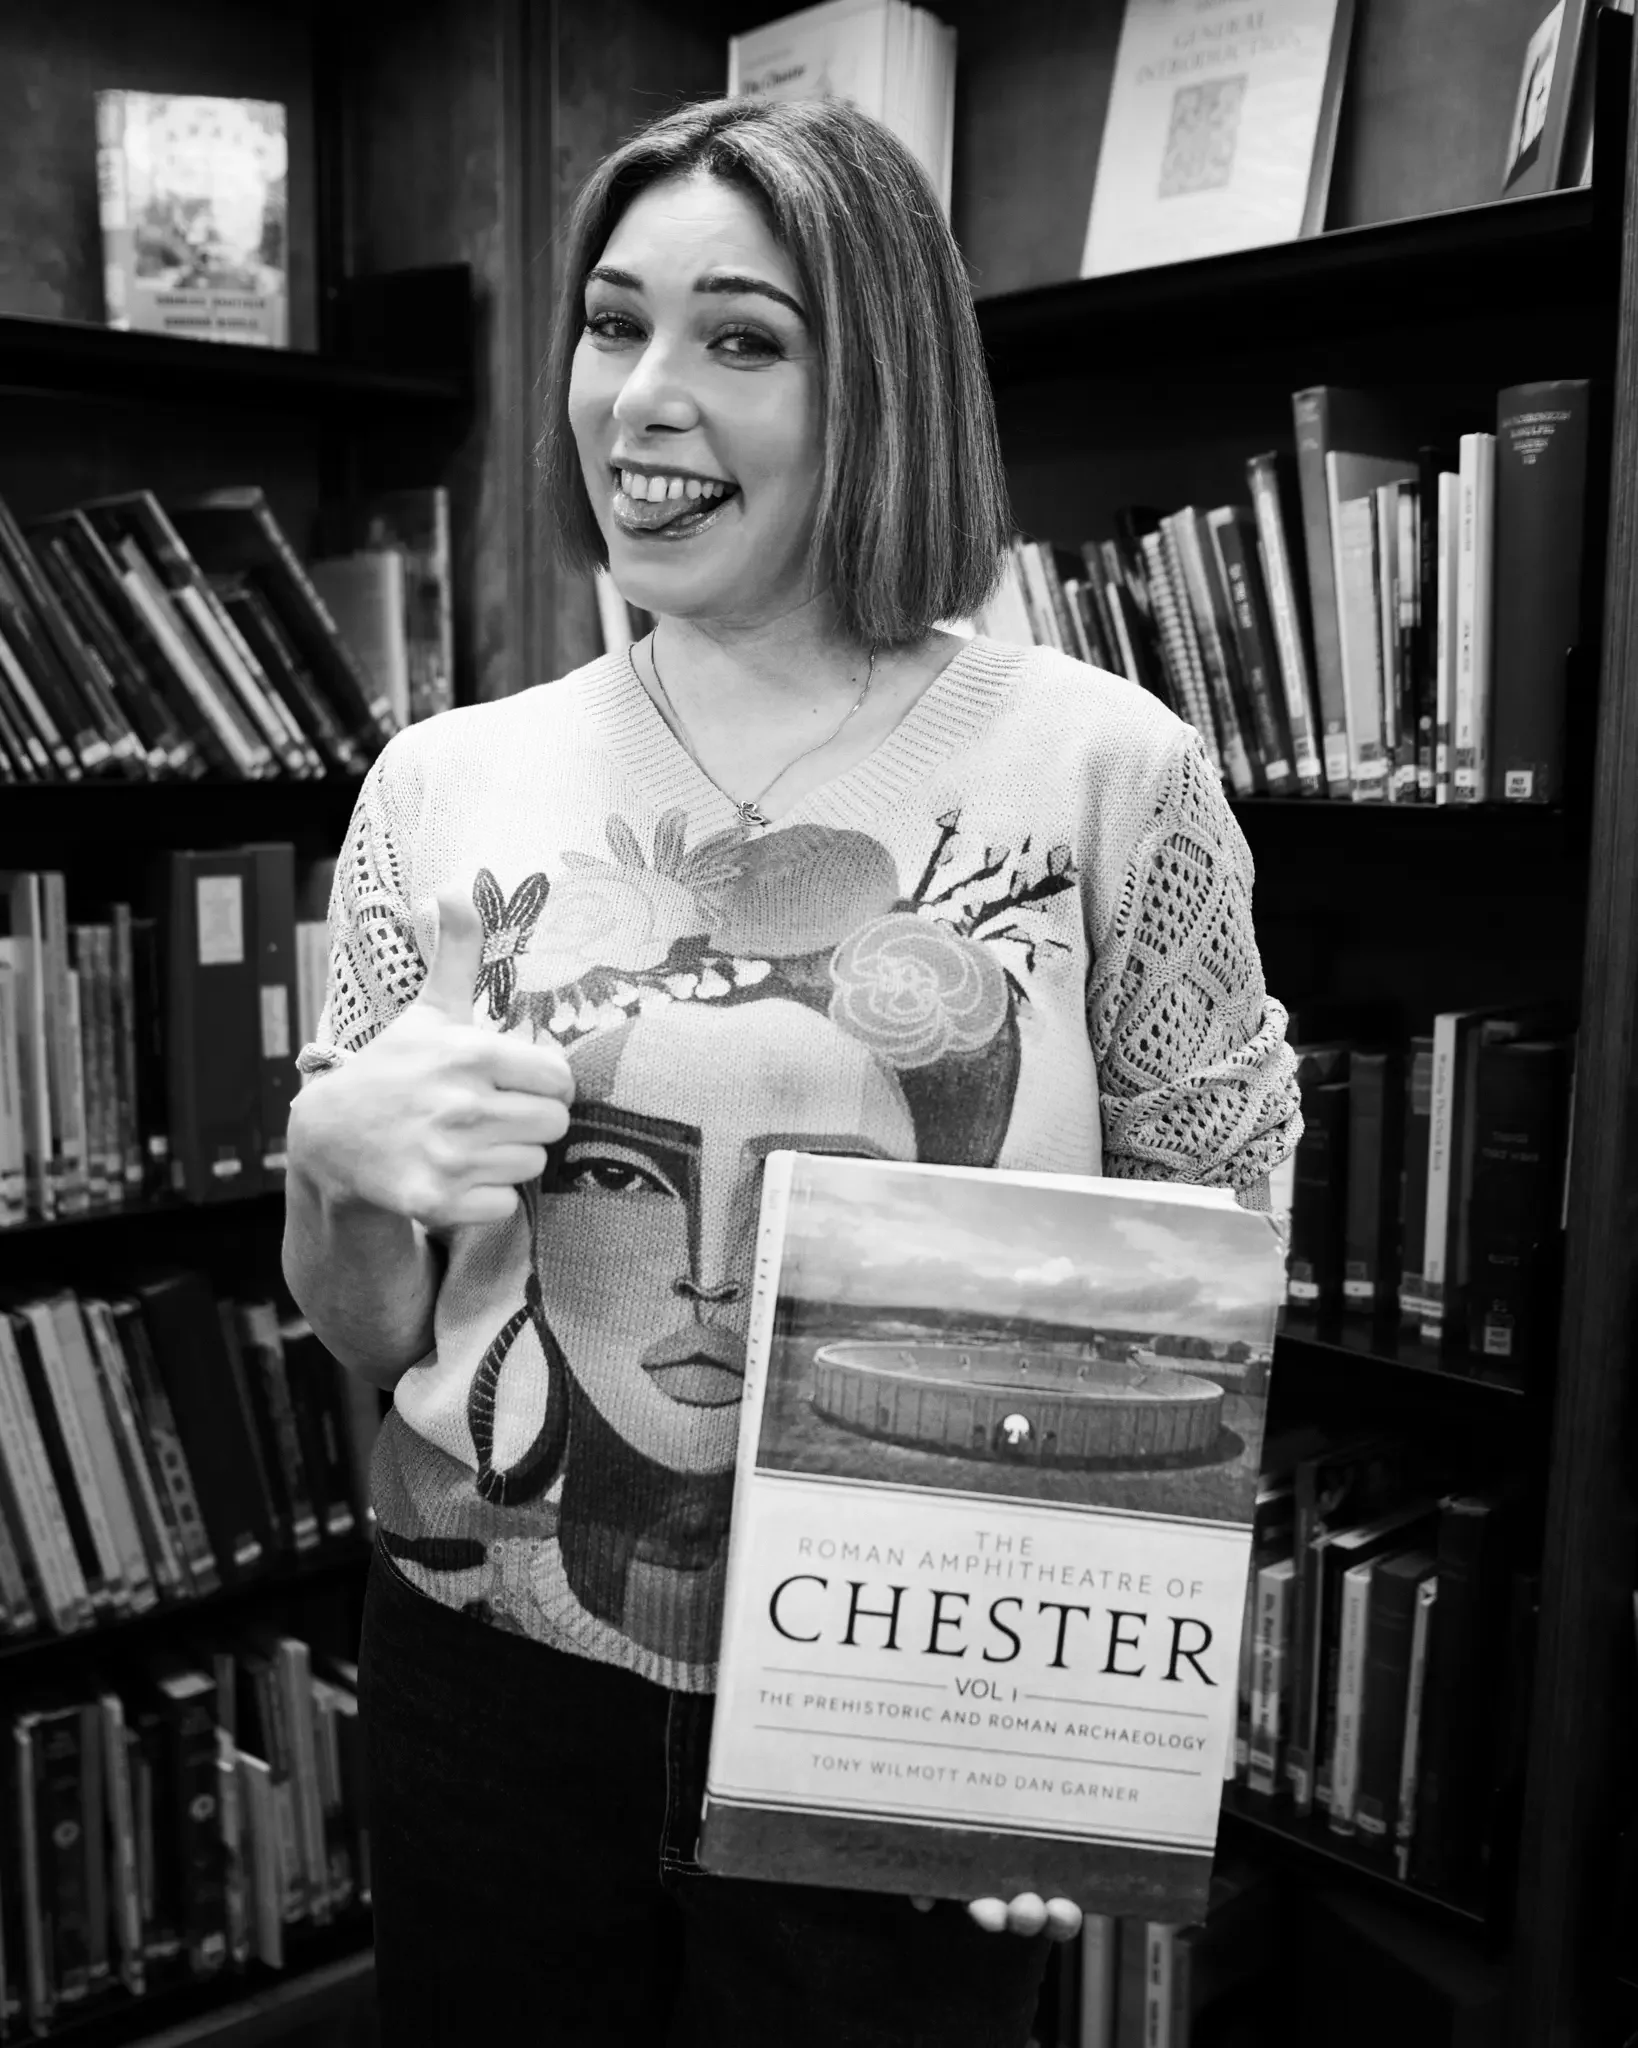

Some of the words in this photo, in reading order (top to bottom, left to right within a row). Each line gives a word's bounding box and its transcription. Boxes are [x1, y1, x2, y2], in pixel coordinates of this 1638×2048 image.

[799, 1536, 905, 1567] ROMAN
[918, 1550, 1152, 1595] AMPHITHEATRE
[1166, 1578, 1204, 1600] OF
[975, 1530, 1034, 1556] THE
[769, 1574, 1219, 1687] CHESTER
[955, 1676, 1003, 1702] VOL
[759, 1688, 794, 1707] THE
[804, 1694, 934, 1722] PREHISTORIC
[940, 1710, 982, 1727] AND
[988, 1712, 1057, 1735] ROMAN
[1064, 1722, 1206, 1751] ARCHAEOLOGY
[811, 1753, 862, 1773] TONY
[870, 1760, 960, 1783] WILMOTT
[967, 1771, 1008, 1788] AND
[1014, 1774, 1054, 1794] DAN
[1060, 1780, 1140, 1802] GARNER
